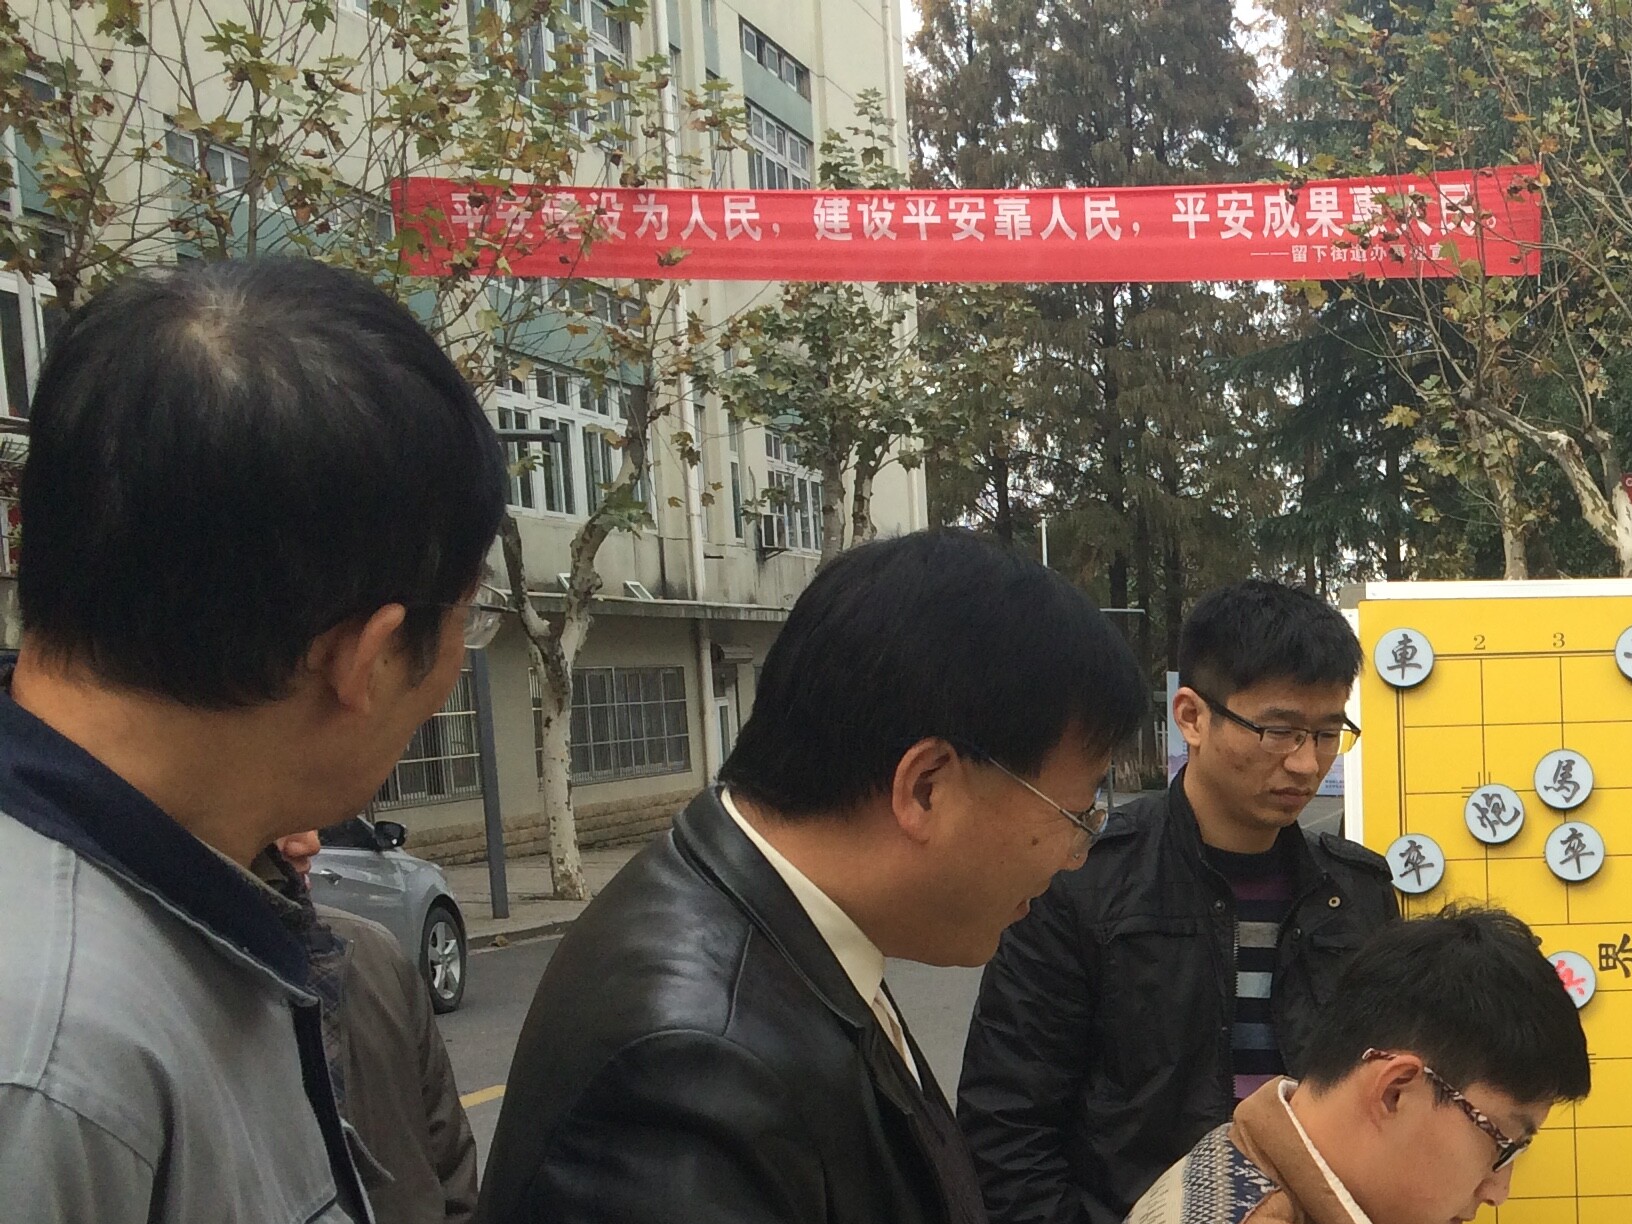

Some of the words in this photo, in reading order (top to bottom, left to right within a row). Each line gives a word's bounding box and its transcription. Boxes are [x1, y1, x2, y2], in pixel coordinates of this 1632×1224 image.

[1473, 634, 1487, 650] 2
[1553, 632, 1566, 649] 3
[1387, 634, 1422, 680] 車
[1472, 793, 1521, 838] 炮
